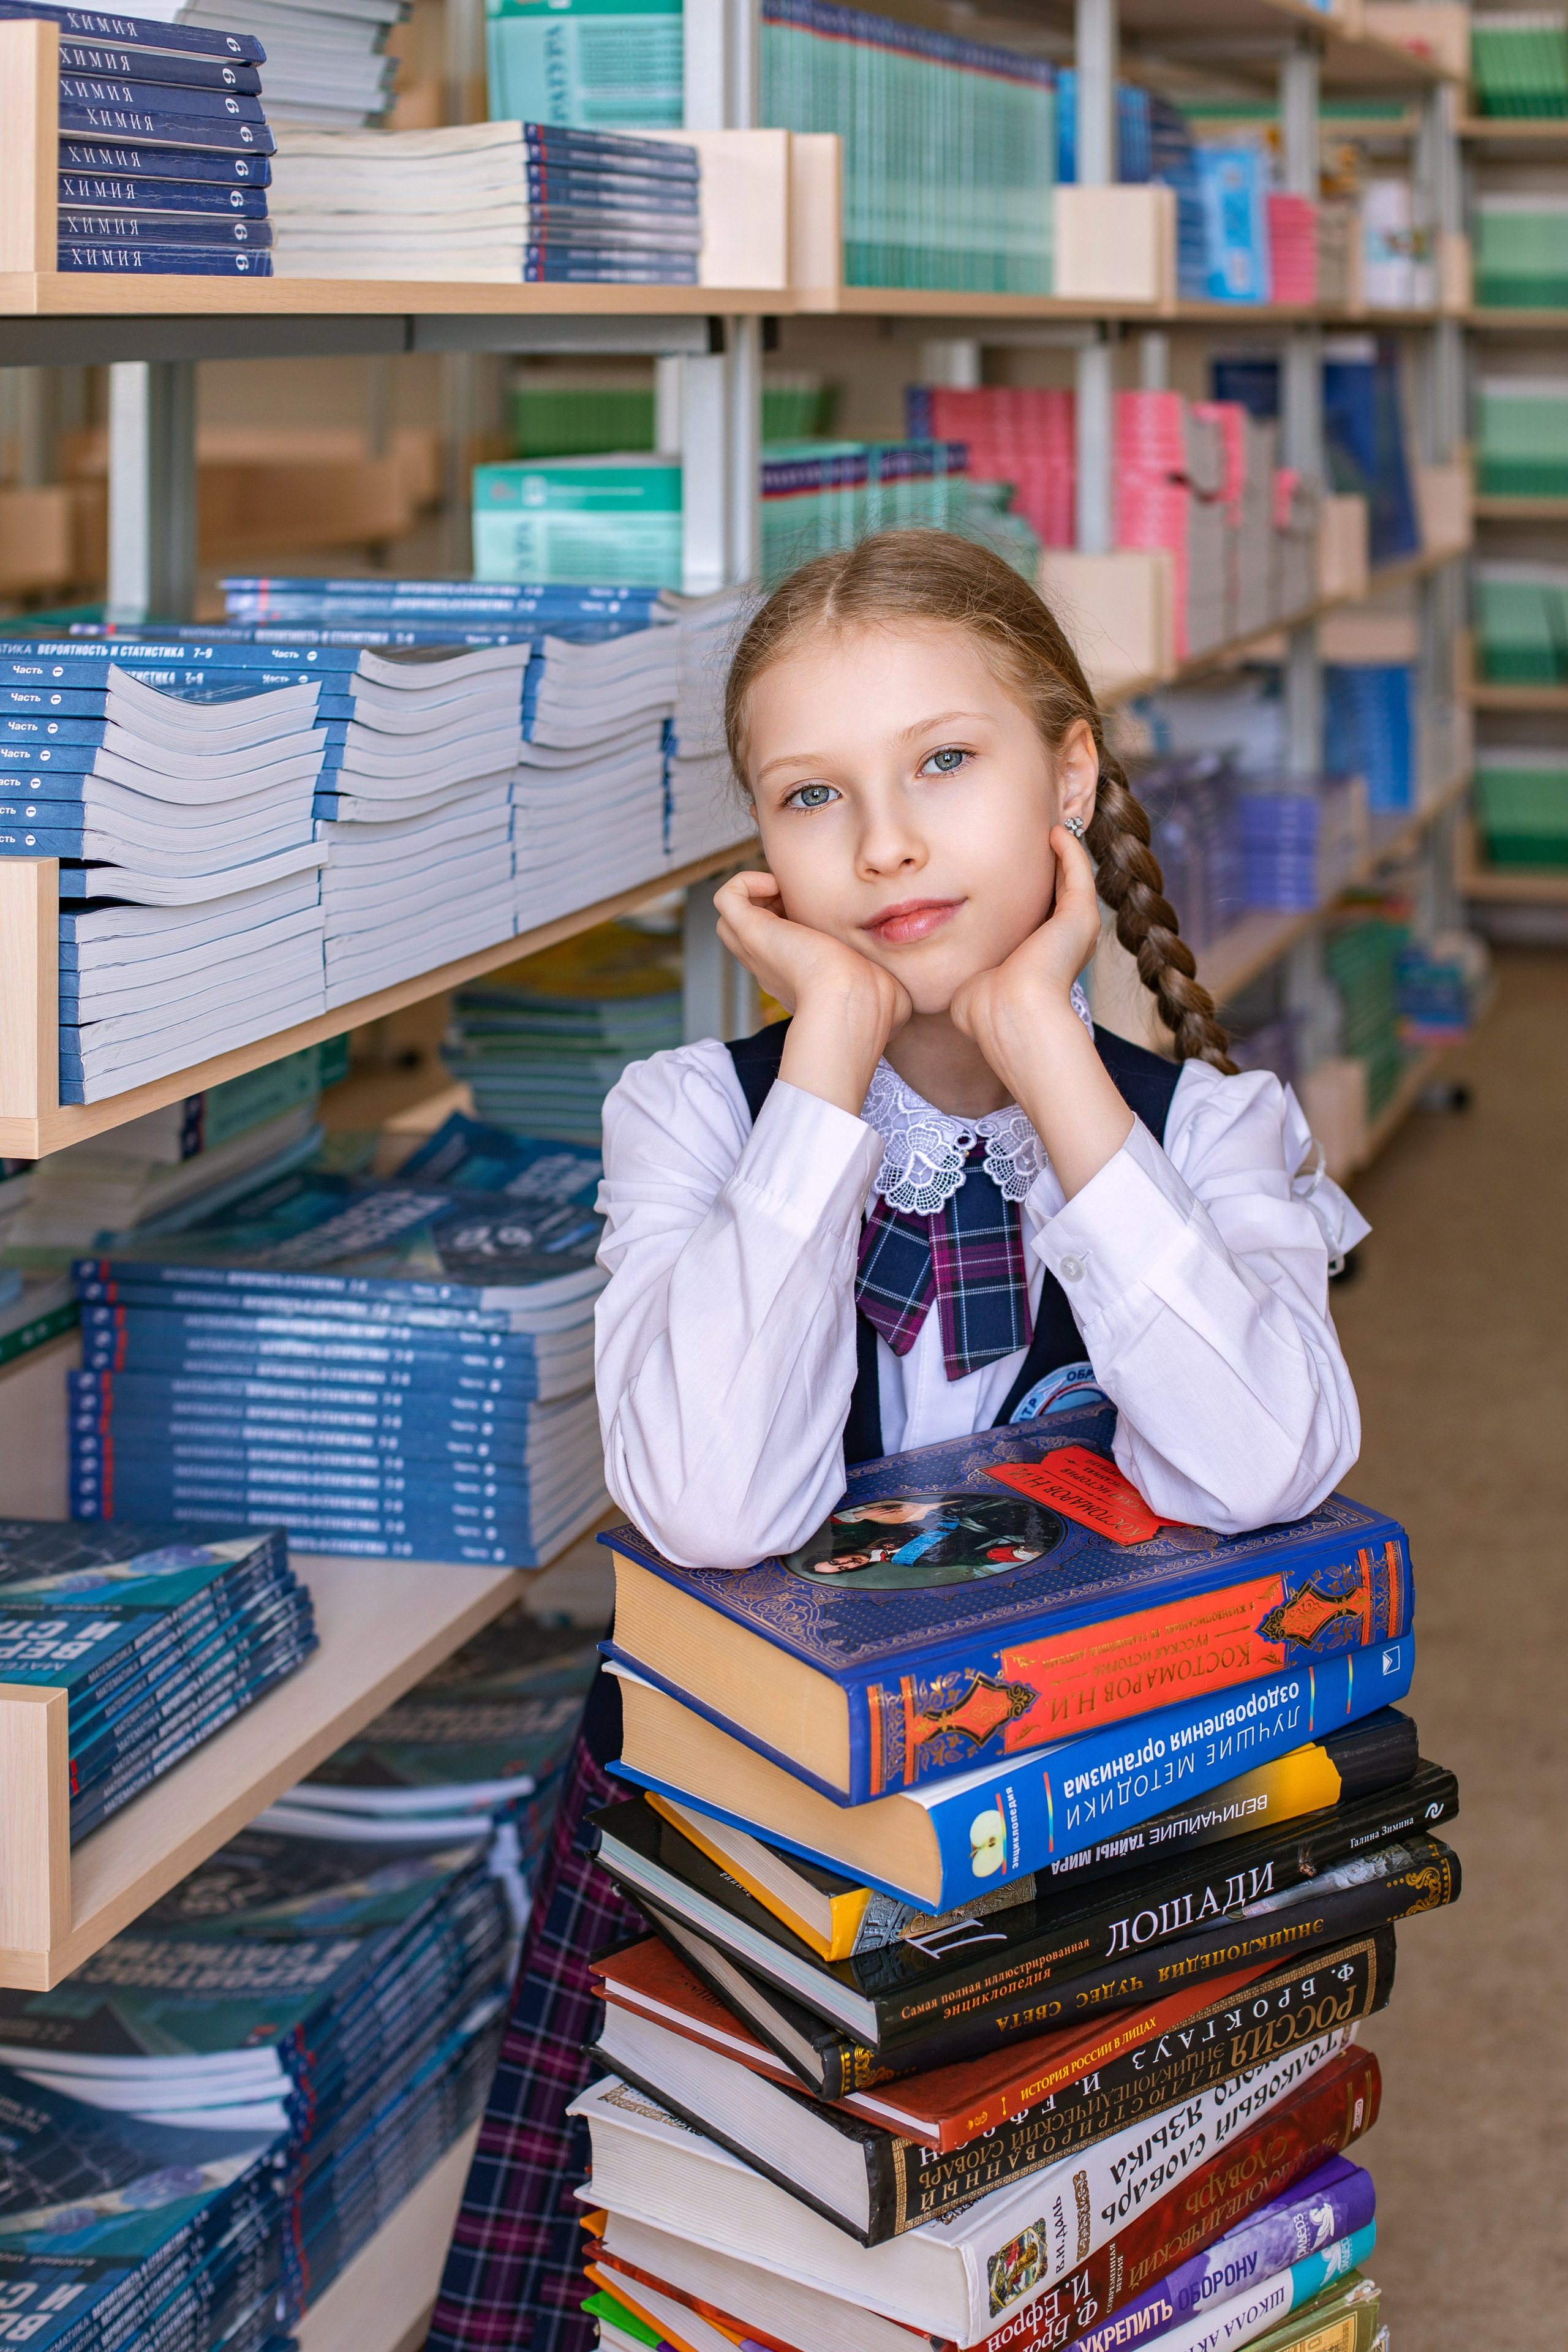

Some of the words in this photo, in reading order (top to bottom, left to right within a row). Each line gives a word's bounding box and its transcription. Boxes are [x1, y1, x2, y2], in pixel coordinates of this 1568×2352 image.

[66, 12, 138, 37] ХИМИЯ
[59, 48, 131, 71] ХИМИЯ
[60, 80, 134, 103] ХИМИЯ
[86, 108, 154, 131] ХИМИЯ
[67, 146, 141, 167] ХИМИЯ
[64, 179, 135, 200] ХИМИЯ
[68, 217, 139, 236] ХИМИЯ
[71, 249, 142, 267] ХИМИЯ
[37, 643, 108, 657] ВЕРОЯТНОСТЬ
[110, 646, 118, 657] И
[120, 646, 184, 658] СТАТИСТИКА
[272, 649, 300, 658] Часть
[12, 665, 43, 674] Часть
[10, 693, 41, 702] Часть
[7, 722, 38, 731] Часть
[1, 749, 31, 758] Часть
[1060, 1468, 1112, 1494] ИСТОРИЯ
[1045, 1485, 1147, 1538] КОСТОМАРОВ
[1094, 1652, 1152, 1678] ИСТОРИЯ
[1156, 1634, 1209, 1662] РУССКАЯ
[1105, 1642, 1251, 1703] КОСТОМАРОВ
[1044, 1687, 1096, 1723] Н.И.
[1170, 1682, 1300, 1752] оздоровления
[1207, 1705, 1300, 1765] ЛУЧШИЕ
[1064, 1739, 1165, 1799] организма
[1066, 1753, 1194, 1830] МЕТОДИКИ
[1008, 1786, 1019, 1870] энциклопедия
[1149, 1793, 1267, 1844] ВЕЛИЧАЙШИЕ
[1350, 1831, 1379, 1849] Галина
[1381, 1817, 1414, 1836] Зимина
[1050, 1852, 1091, 1875] МИРА
[1096, 1837, 1145, 1862] ТАЙНЫ
[1106, 1861, 1274, 1956] ЛОШАДИ
[1158, 1918, 1324, 1981] ЭНЦИКЛОПЕДИЯ
[901, 1996, 938, 2019] Самая
[941, 1981, 981, 2005] полная
[984, 1938, 1090, 1985] иллюстрированная
[1331, 1962, 1355, 1982] Ф.
[1077, 1977, 1144, 2008] ЧУДЕС
[995, 2001, 1062, 2032] СВЕТА
[1132, 1977, 1317, 2070] БРОКГАУЗ
[1231, 1984, 1357, 2068] РОССИЯ
[1020, 2068, 1070, 2101] ИСТОРИЯ
[1071, 2043, 1112, 2075] РОССИИ
[1114, 2037, 1120, 2049] В
[1121, 2016, 1157, 2046] ЛИЦАХ
[1011, 2043, 1225, 2154] ЭНЦИКЛОПЕДИЧЕСКИЙ
[1075, 2072, 1101, 2097] И.
[920, 2060, 1223, 2211] ИЛЛЮСТРИРОВАННЫЙ
[919, 2139, 1005, 2190] СЛОВАРЬ
[1186, 2136, 1287, 2214] СЛОВАРЬ
[1128, 2132, 1340, 2290] ЭНЦИКЛОПЕДИЧЕСКИЙ
[1340, 2237, 1350, 2274] ридер
[1065, 2269, 1091, 2305] И.
[1106, 2242, 1116, 2313] СОВРЕМЕННАЯ
[1076, 2297, 1098, 2328] Ф.
[1079, 2298, 1173, 2352] УКРЕПИТЬ
[1178, 2251, 1259, 2312] ОБОРОНУ
[1223, 2286, 1286, 2340] ШКОЛА
[986, 2289, 1061, 2351] Ефрон
